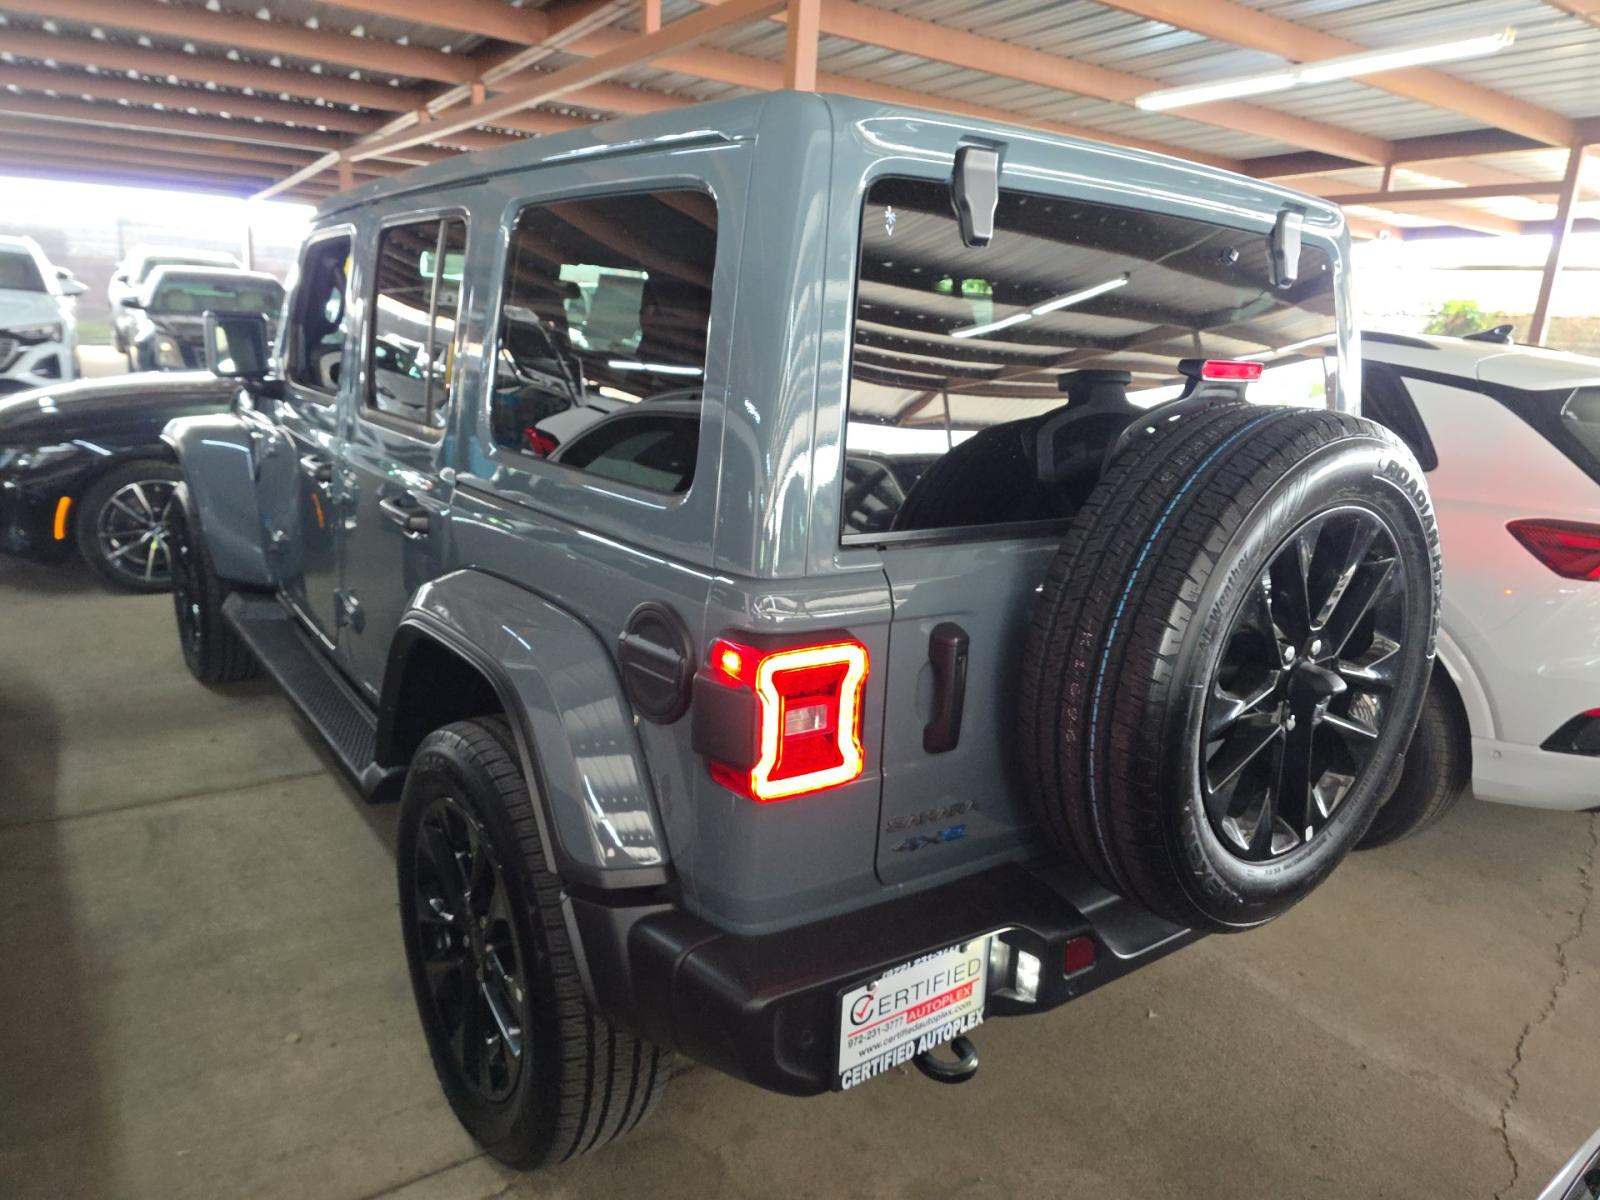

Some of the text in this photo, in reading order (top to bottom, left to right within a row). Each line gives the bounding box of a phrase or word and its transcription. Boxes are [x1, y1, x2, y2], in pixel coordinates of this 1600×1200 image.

[1384, 460, 1440, 548] ROADIAN
[851, 957, 981, 1026] CERTIFIED
[907, 985, 973, 1022] AUTOPLEX
[841, 1008, 985, 1091] CERTIFIED AUTOPLEX
[847, 1016, 904, 1048] 972-231-3777
[858, 1000, 972, 1057] www.certifiedautoplex.com
